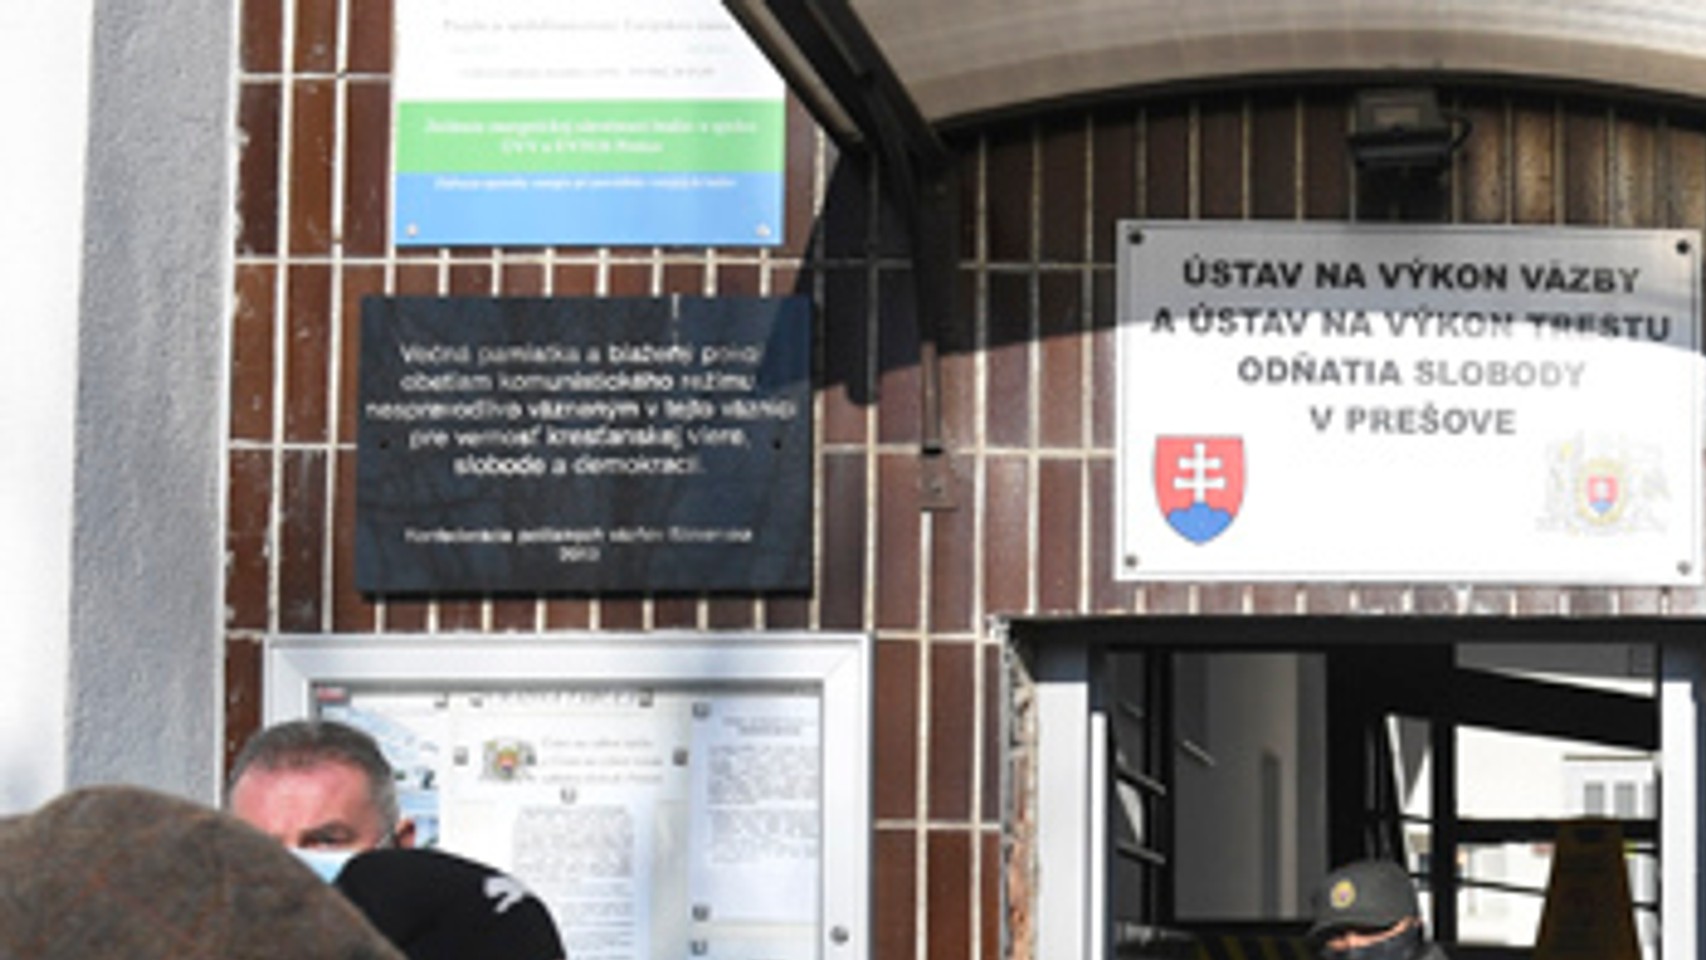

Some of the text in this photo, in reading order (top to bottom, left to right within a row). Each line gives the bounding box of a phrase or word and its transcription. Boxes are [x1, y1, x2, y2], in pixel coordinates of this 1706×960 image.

[1183, 253, 1641, 294] ÚSTAV NA VÝKON VÄZBY
[1151, 302, 1671, 343] A ÚSTAV NA VÝKON TRESTU
[477, 344, 581, 369] pamiatka
[586, 347, 601, 364] a
[399, 371, 493, 392] obetiam
[499, 371, 675, 392] komunistického
[1237, 351, 1587, 389] ODŇATIA SLOBODY
[645, 403, 659, 419] v
[1309, 401, 1517, 436] V PREŠOVE
[409, 430, 449, 450] pre
[453, 454, 547, 476] slobode
[551, 458, 567, 475] a
